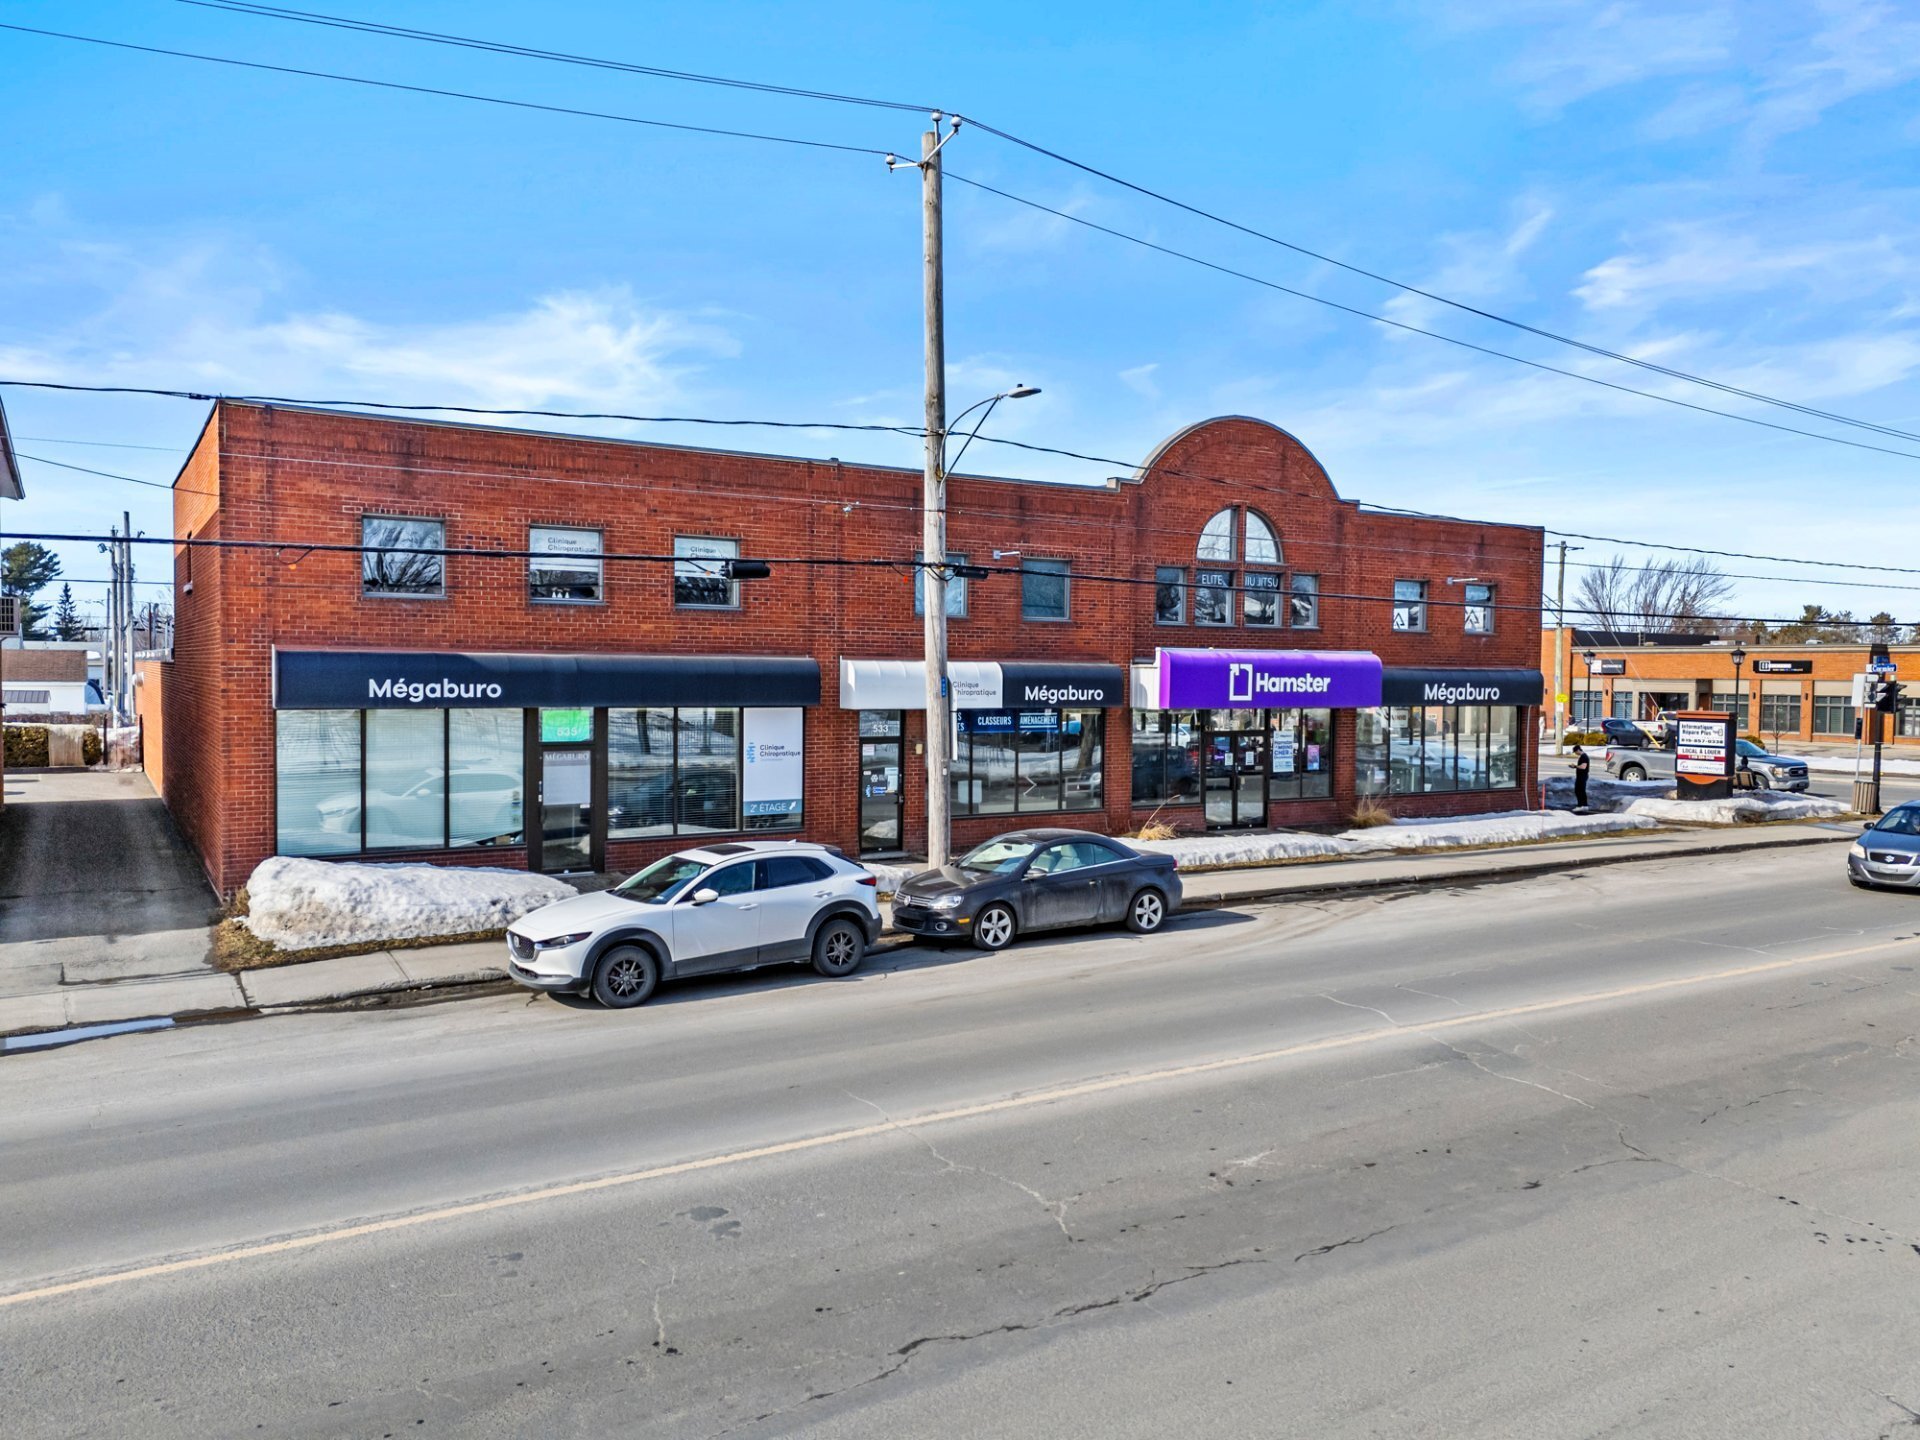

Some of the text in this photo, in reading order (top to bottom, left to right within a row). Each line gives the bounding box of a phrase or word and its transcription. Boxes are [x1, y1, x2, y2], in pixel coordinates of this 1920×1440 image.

[548, 537, 577, 545] Clinique
[1201, 574, 1223, 585] ELITE
[952, 681, 979, 689] Clinique
[1256, 672, 1331, 692] Hamster
[368, 678, 502, 703] Mégaburo
[954, 688, 997, 697] hiropratique
[1024, 684, 1104, 704] Mégaburo
[1424, 682, 1500, 704] Mégaburo
[977, 716, 1012, 726] CLASSEURS
[1019, 715, 1058, 725] AMÉNAGEMENT
[872, 724, 889, 733] 533
[760, 744, 785, 752] Clinique
[760, 750, 801, 758] Chiropratique
[760, 802, 787, 812] ÉTAGE
